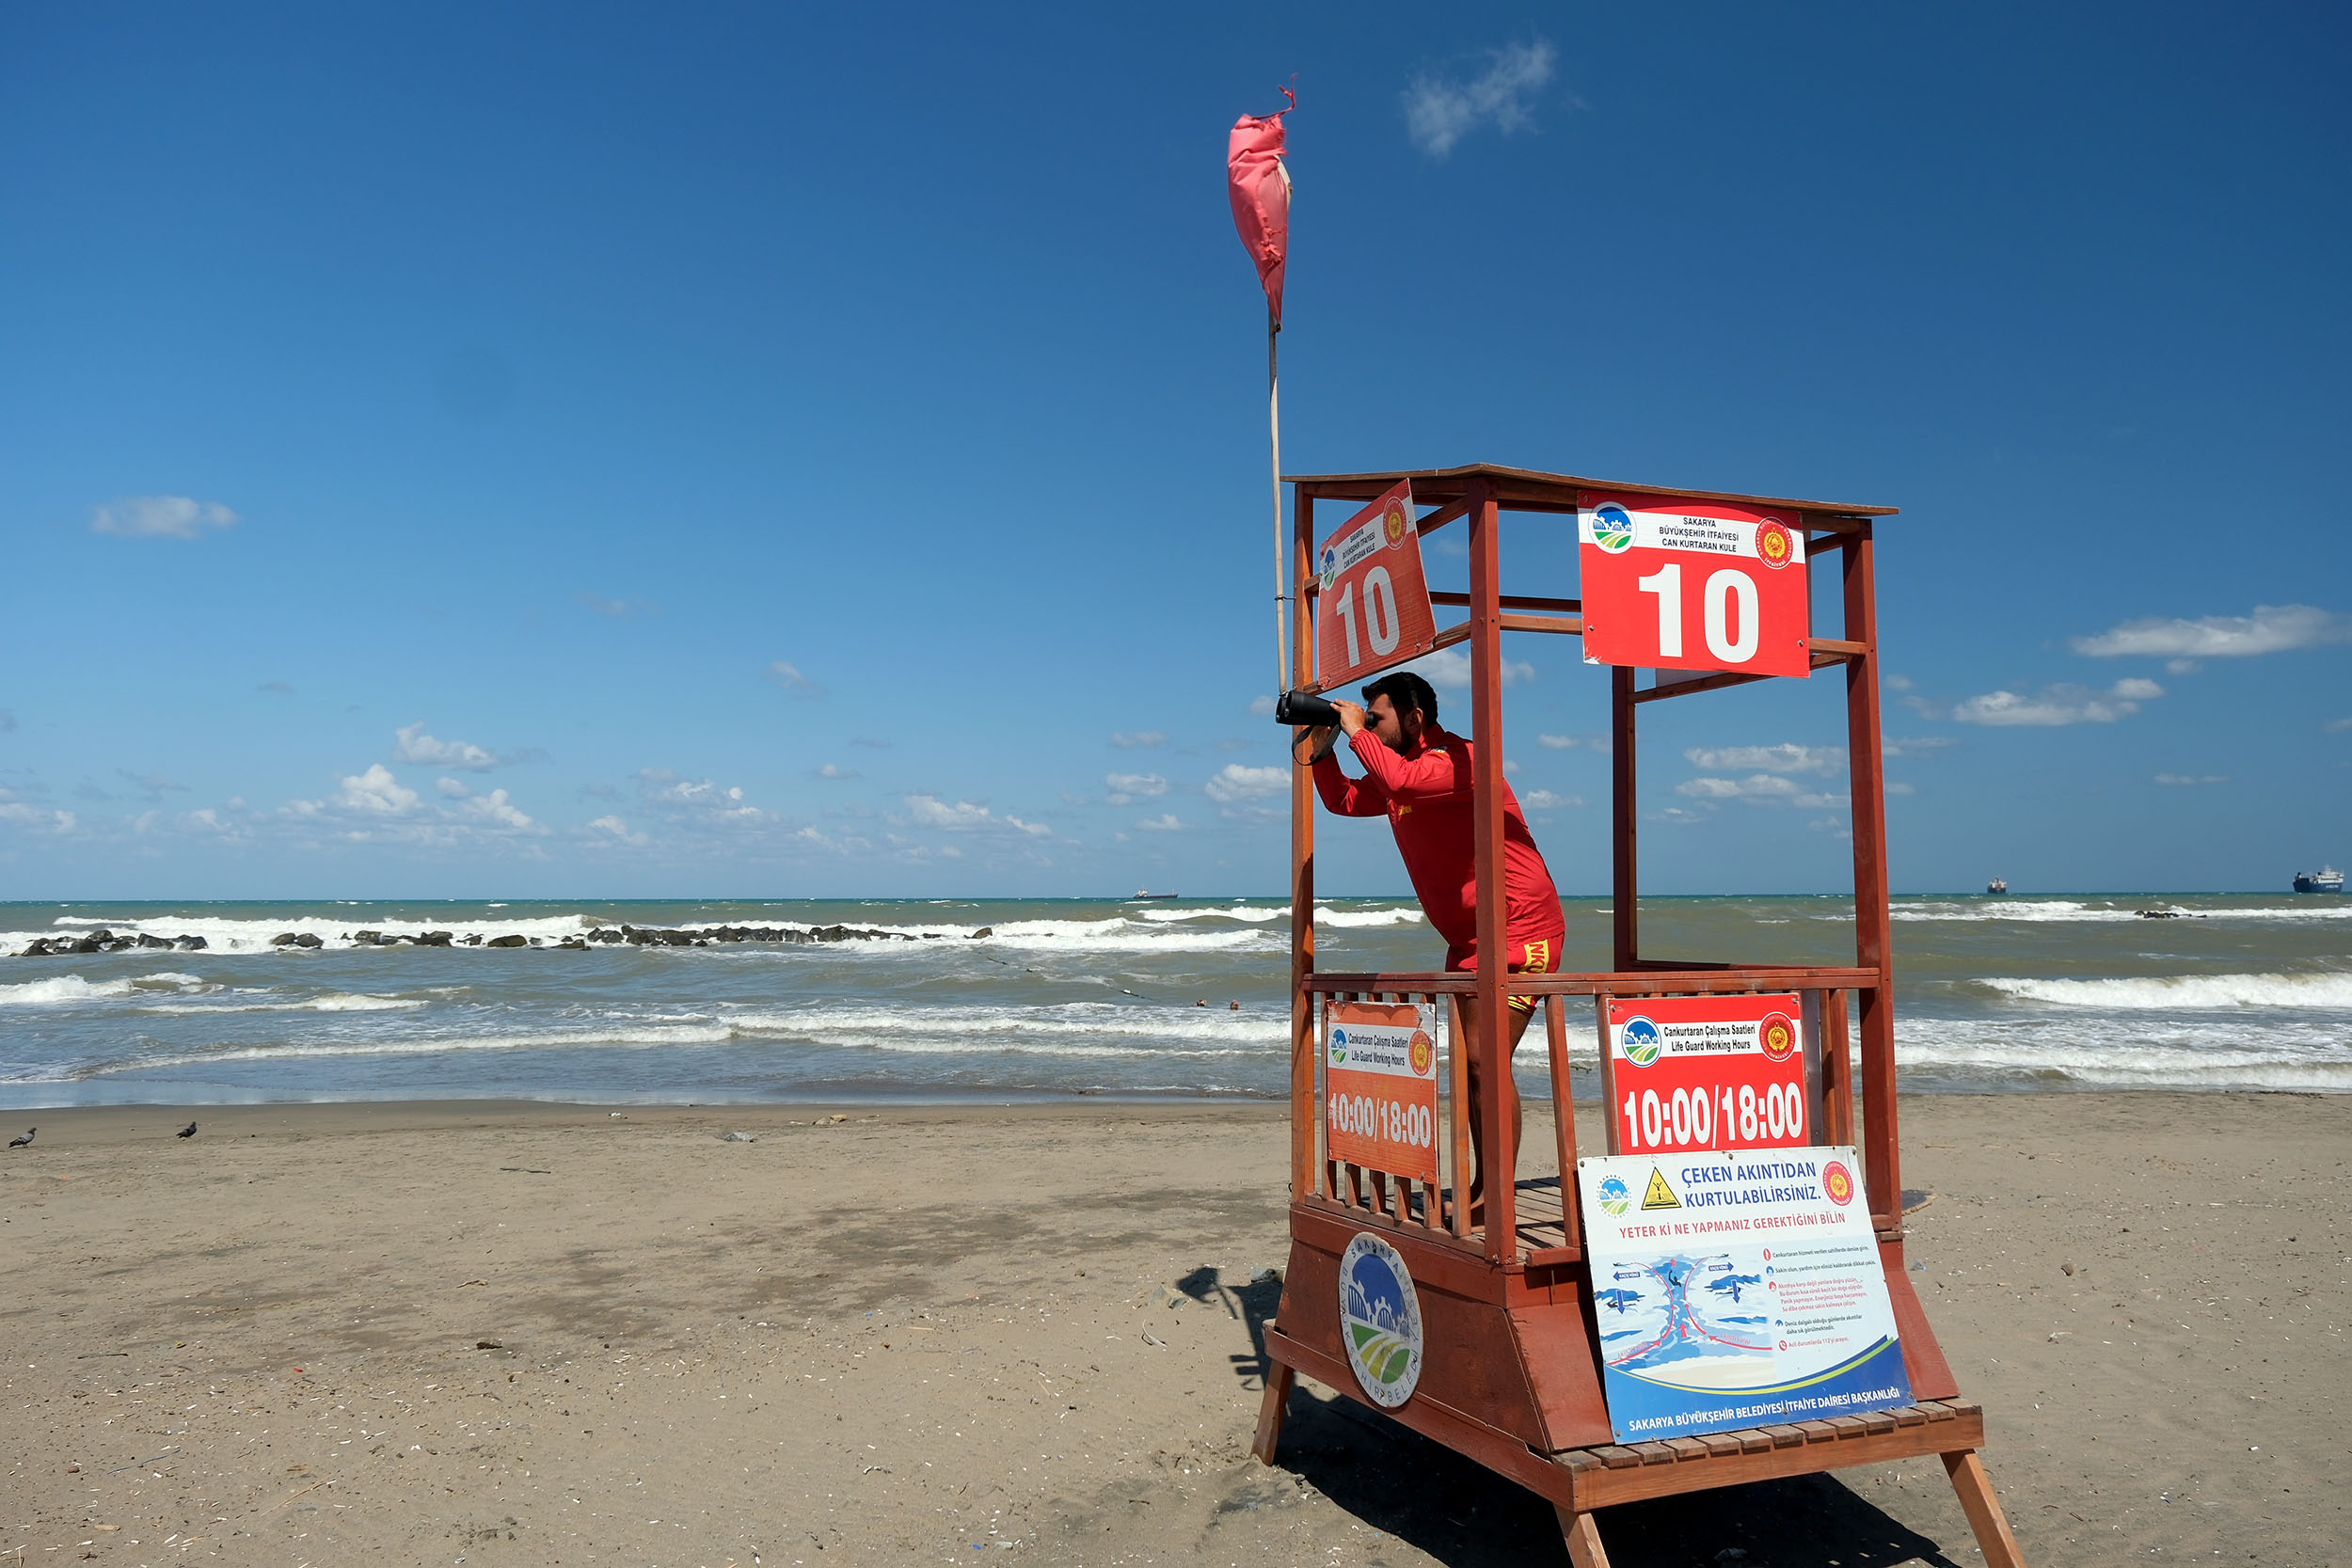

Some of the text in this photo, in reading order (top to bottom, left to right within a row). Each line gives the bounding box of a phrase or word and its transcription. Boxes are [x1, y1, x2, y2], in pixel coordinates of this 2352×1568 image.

[1660, 525, 1740, 541] BÜYÜKŞEHİR İTFAİYESİ
[1683, 516, 1716, 528] SAKARYA
[1661, 538, 1737, 552] CAN KURTARAN KULE
[1336, 565, 1400, 668] 10
[1638, 562, 1759, 663] 10
[1348, 1033, 1408, 1050] Cankurtaran Çalışma Saatleri
[1664, 1024, 1756, 1038] Cankurtaran Çalışma Saatleri
[1672, 1039, 1751, 1053] Life Guard Working Hours
[1360, 1051, 1373, 1062] Guard
[1374, 1052, 1391, 1068] Working
[1391, 1053, 1406, 1067] Hours
[1330, 1093, 1431, 1148] 10:00/18:00
[1624, 1082, 1803, 1148] 10:00/18:00
[1681, 1165, 1733, 1188] ÇEKEN
[1738, 1162, 1817, 1181] AKINTIDAN
[1685, 1185, 1821, 1208] KURTULABİLİRSİNİZ.
[1620, 1212, 1846, 1239] YETER Kİ NE YAPMANIZ GEREKTİĞİNİ BİLİN
[1351, 1239, 1399, 1274] SAKARYA
[1629, 1386, 1900, 1432] SAKARYA BÜYÜKŞEHİR BELEDİYESİ İTFAİYE DAİRESİ BAŞKANLIĞI
